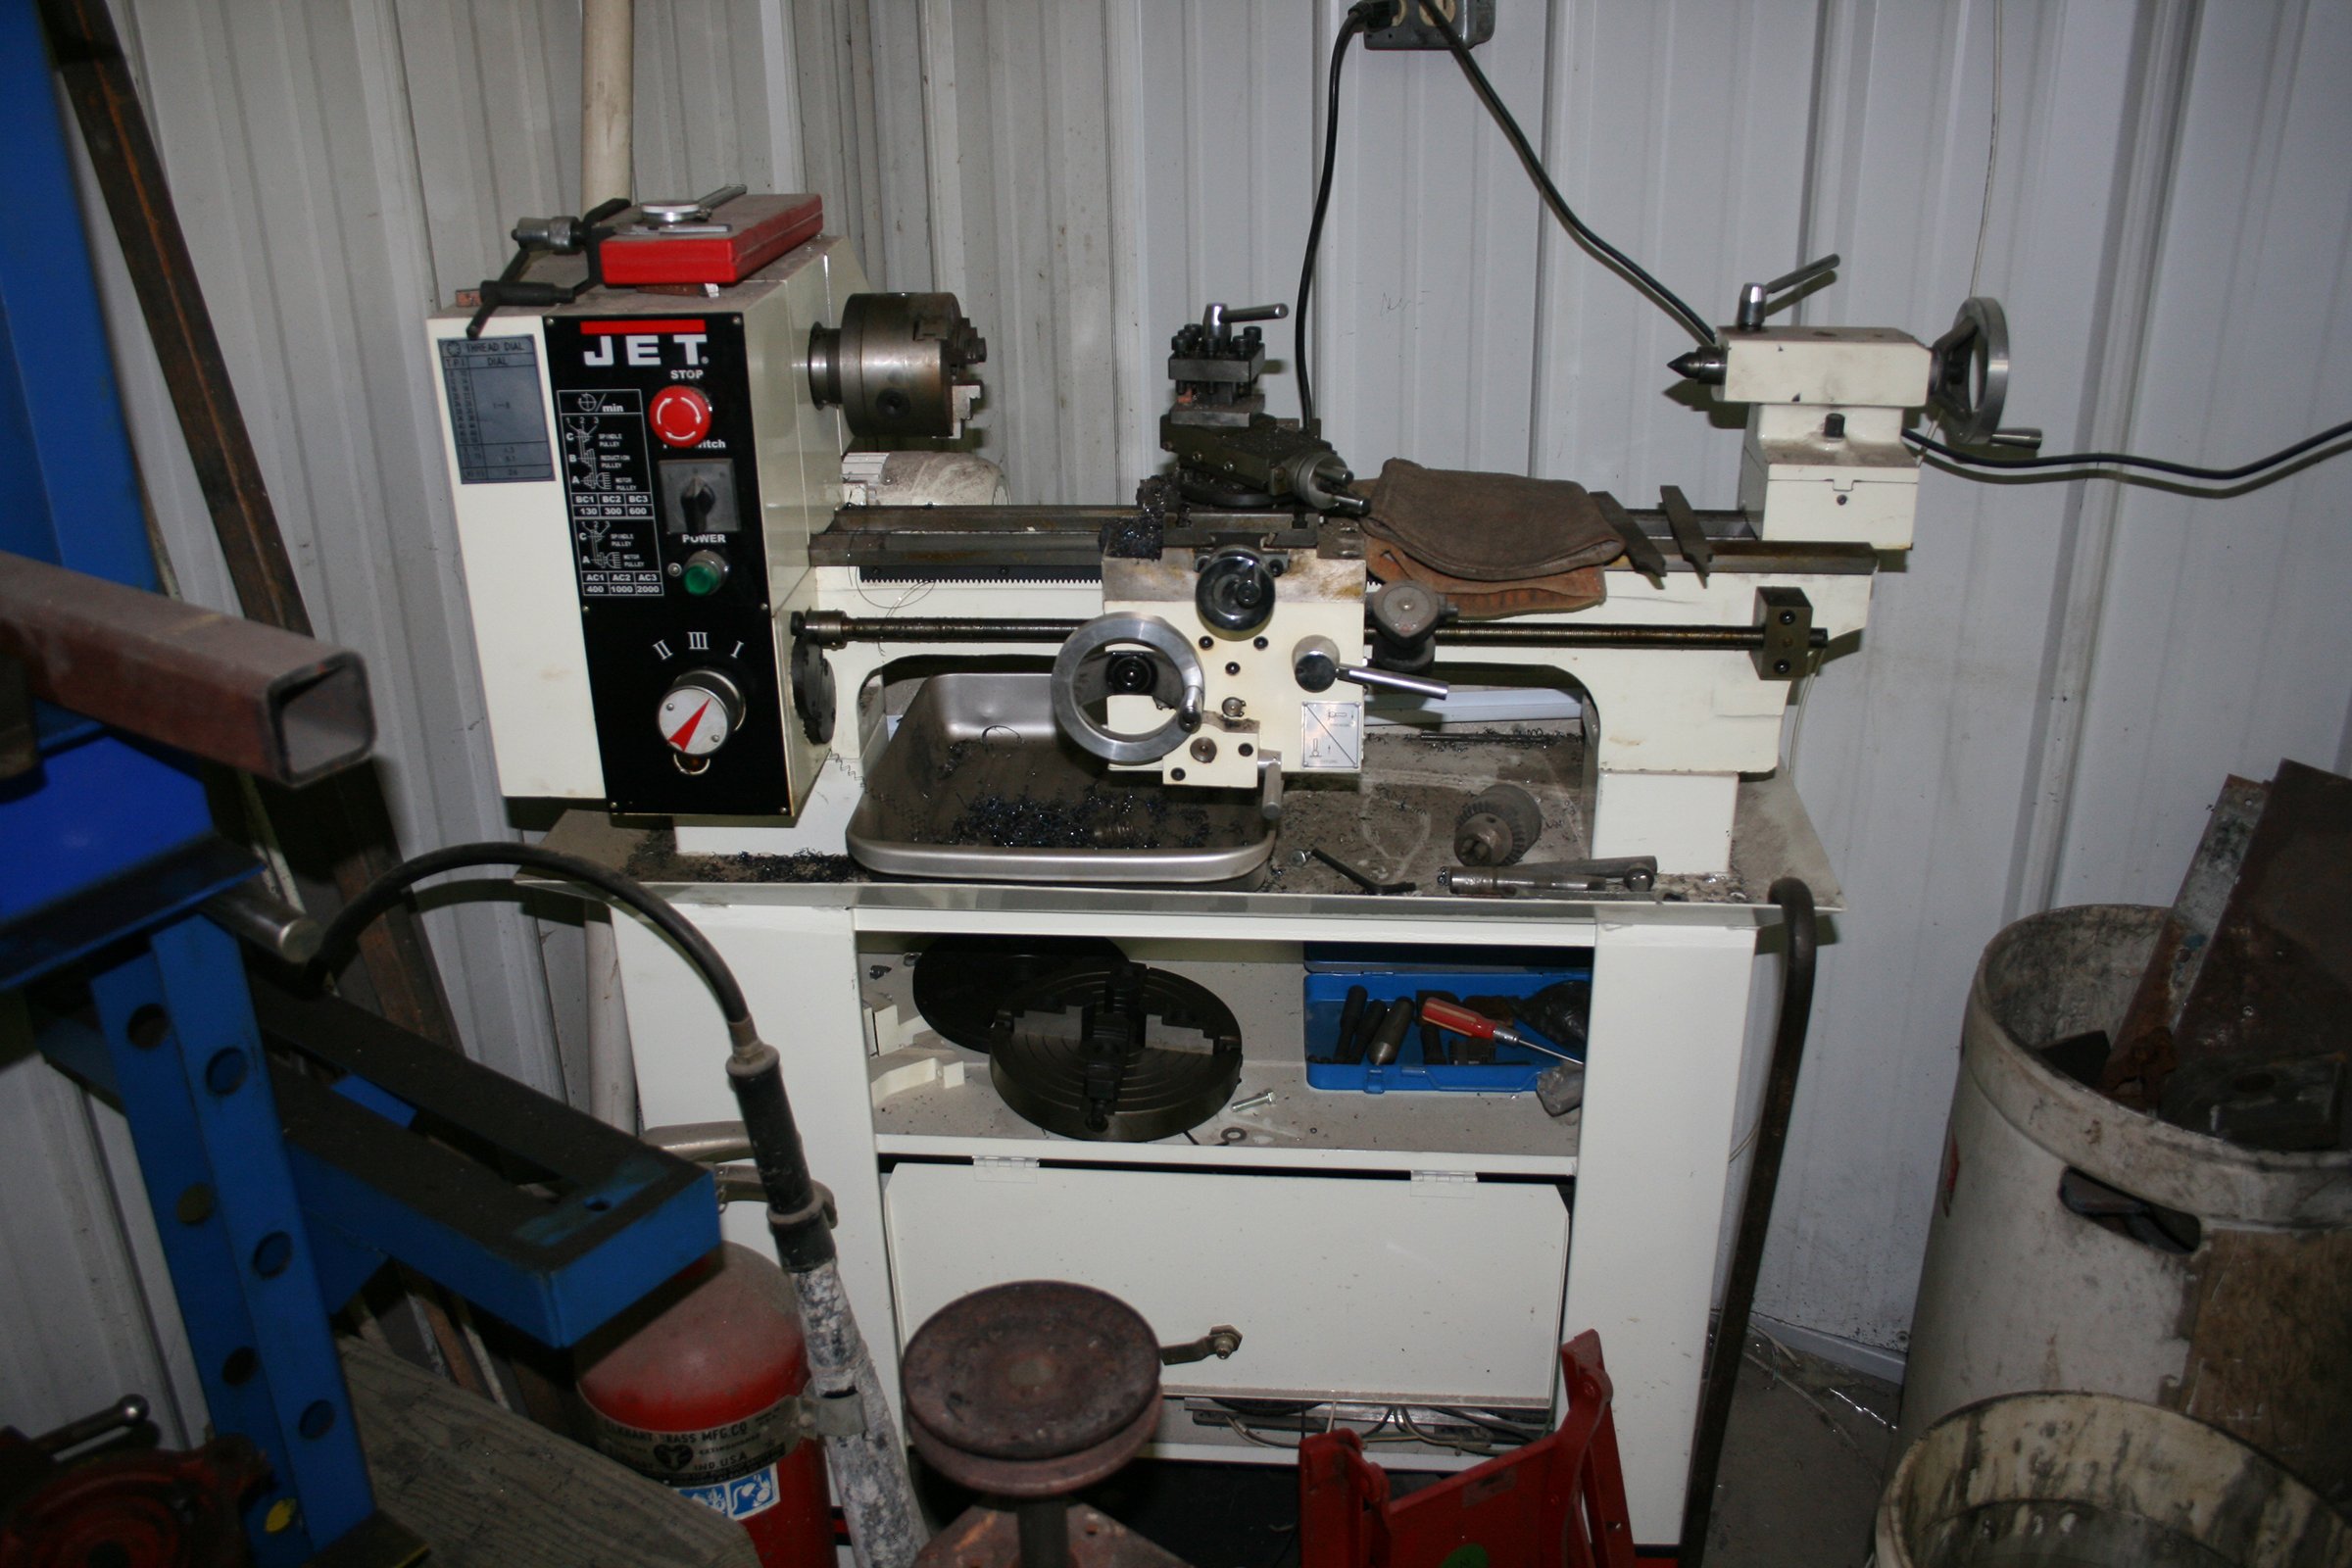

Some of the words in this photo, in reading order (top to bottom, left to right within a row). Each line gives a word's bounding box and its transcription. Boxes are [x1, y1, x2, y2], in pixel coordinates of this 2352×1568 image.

[466, 342, 500, 353] THREAD
[505, 341, 525, 351] DIAL
[583, 334, 708, 366] JET
[486, 357, 509, 366] DIAL
[670, 369, 704, 379] STOP
[568, 454, 577, 463] B
[571, 475, 580, 484] A
[575, 495, 595, 504] BC1
[602, 495, 622, 504] BC2
[628, 507, 647, 515] 600
[681, 533, 727, 544] POWER
[612, 573, 631, 582] AC2
[638, 573, 658, 582] AC3
[586, 585, 605, 594] 400
[611, 585, 633, 594] 1000
[637, 585, 660, 594] 2000
[687, 631, 710, 651] III
